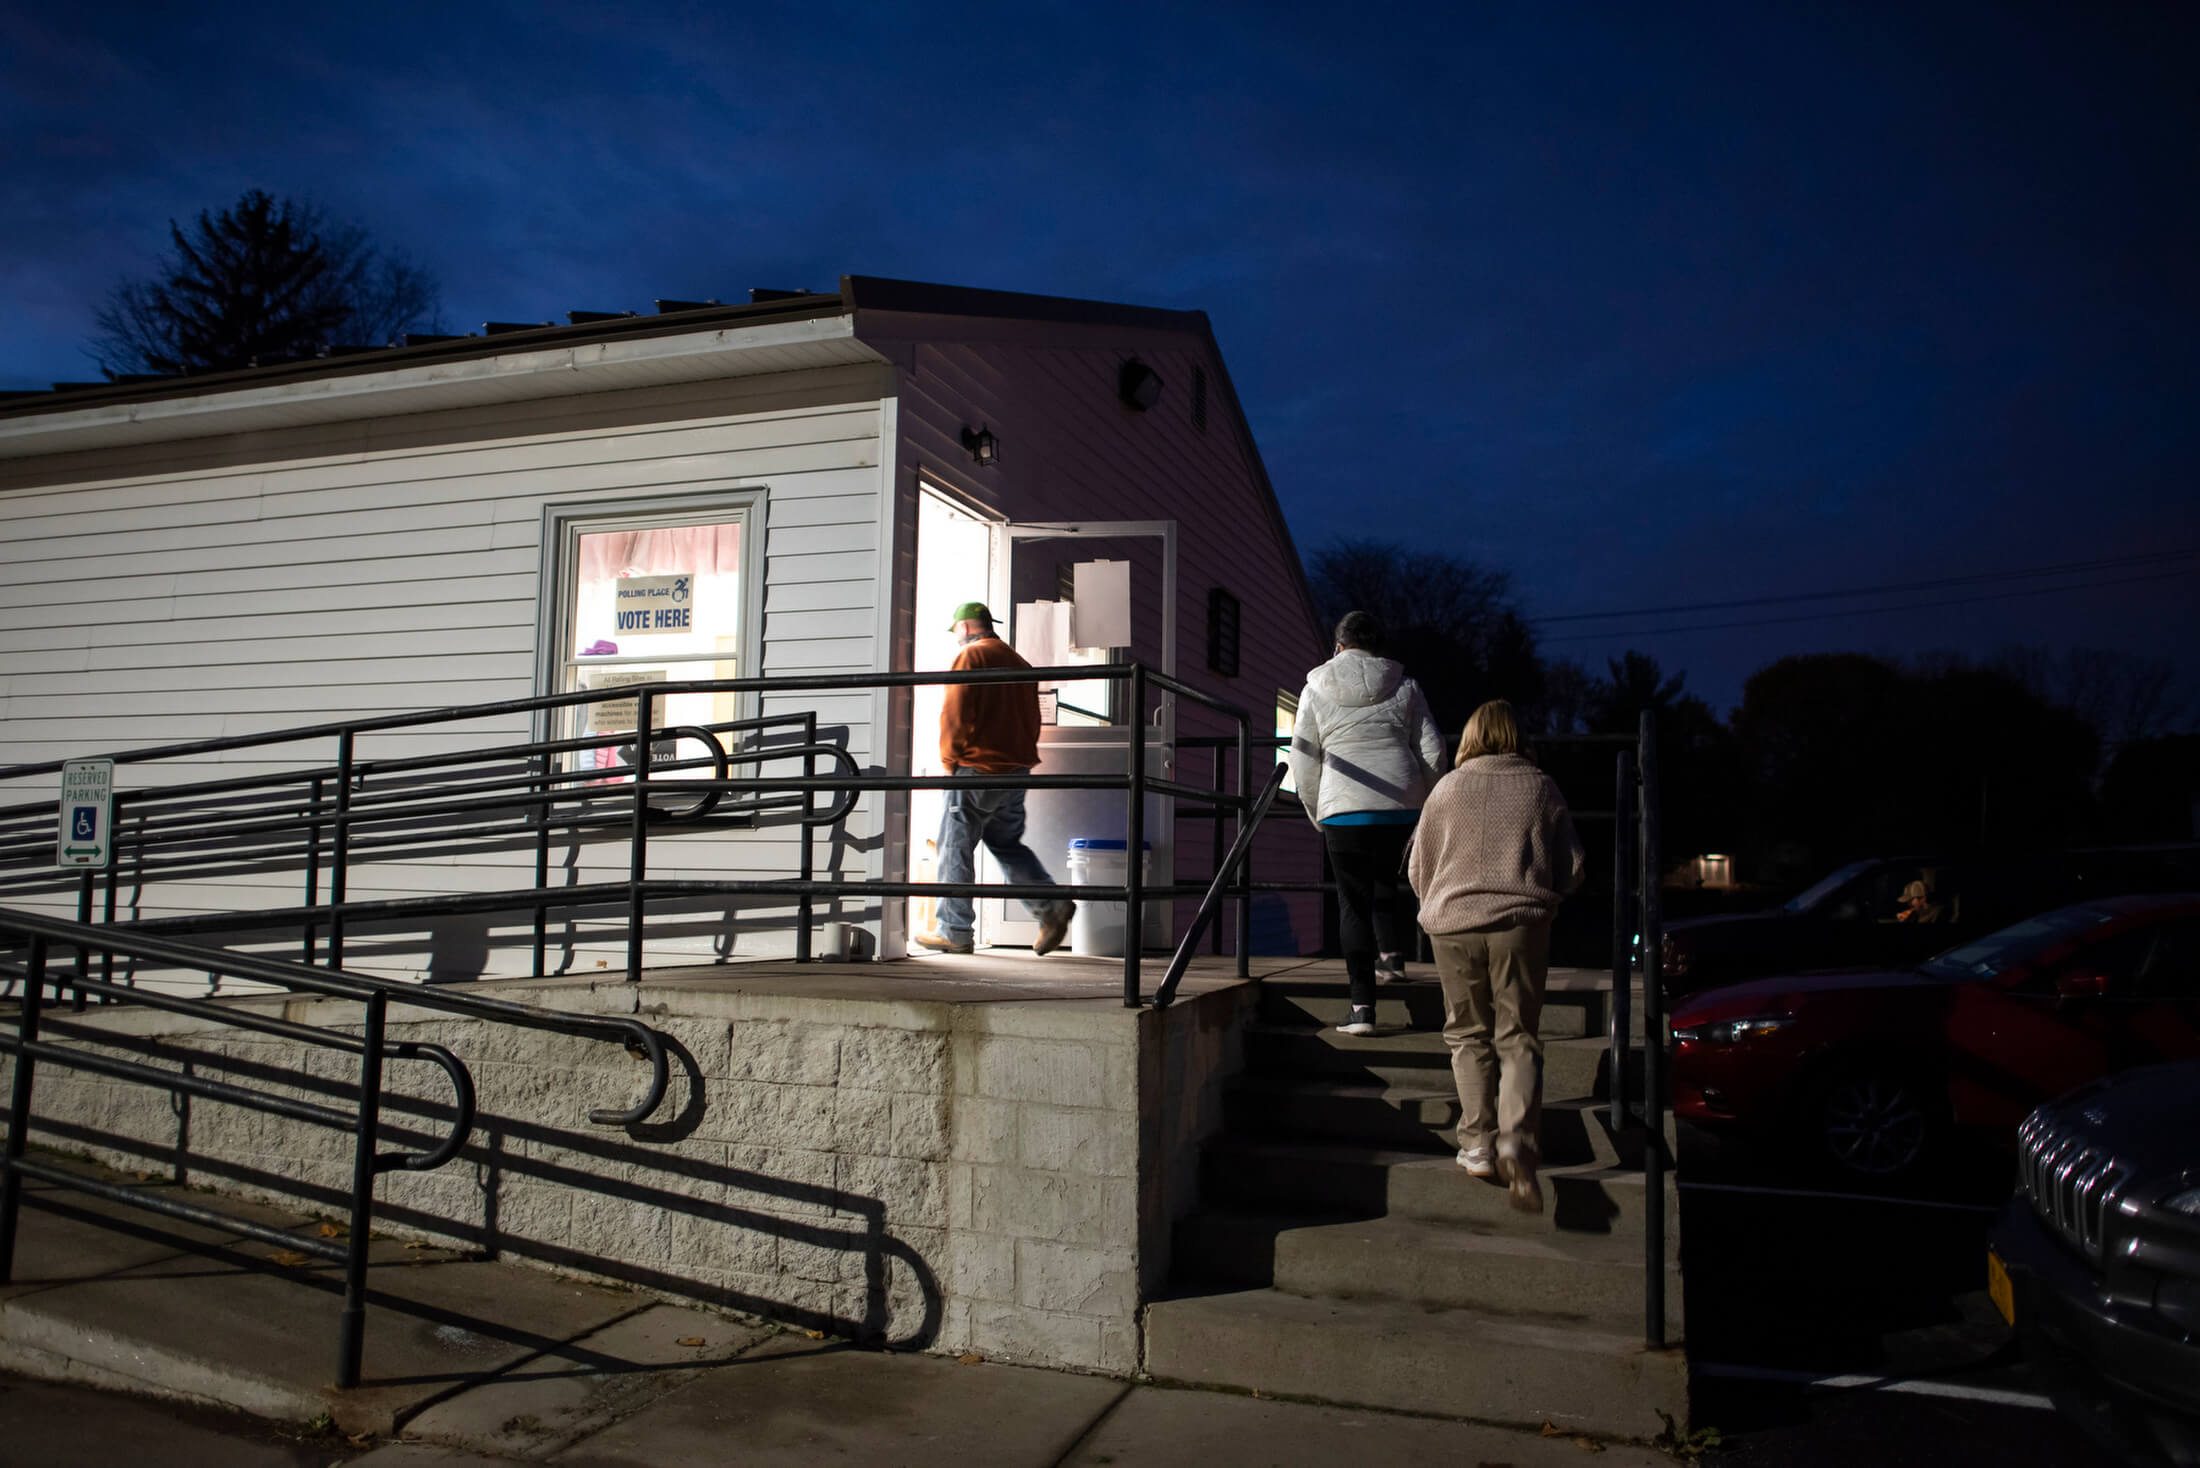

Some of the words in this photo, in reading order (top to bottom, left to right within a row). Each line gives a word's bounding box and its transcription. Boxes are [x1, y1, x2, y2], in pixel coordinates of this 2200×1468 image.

[618, 589, 646, 598] POLLING
[648, 587, 670, 596] PLACE
[617, 610, 650, 630] VOTE
[655, 608, 690, 628] HERE
[652, 753, 675, 761] VOTE
[68, 771, 107, 786] RESERVED
[66, 788, 107, 802] PARKING
